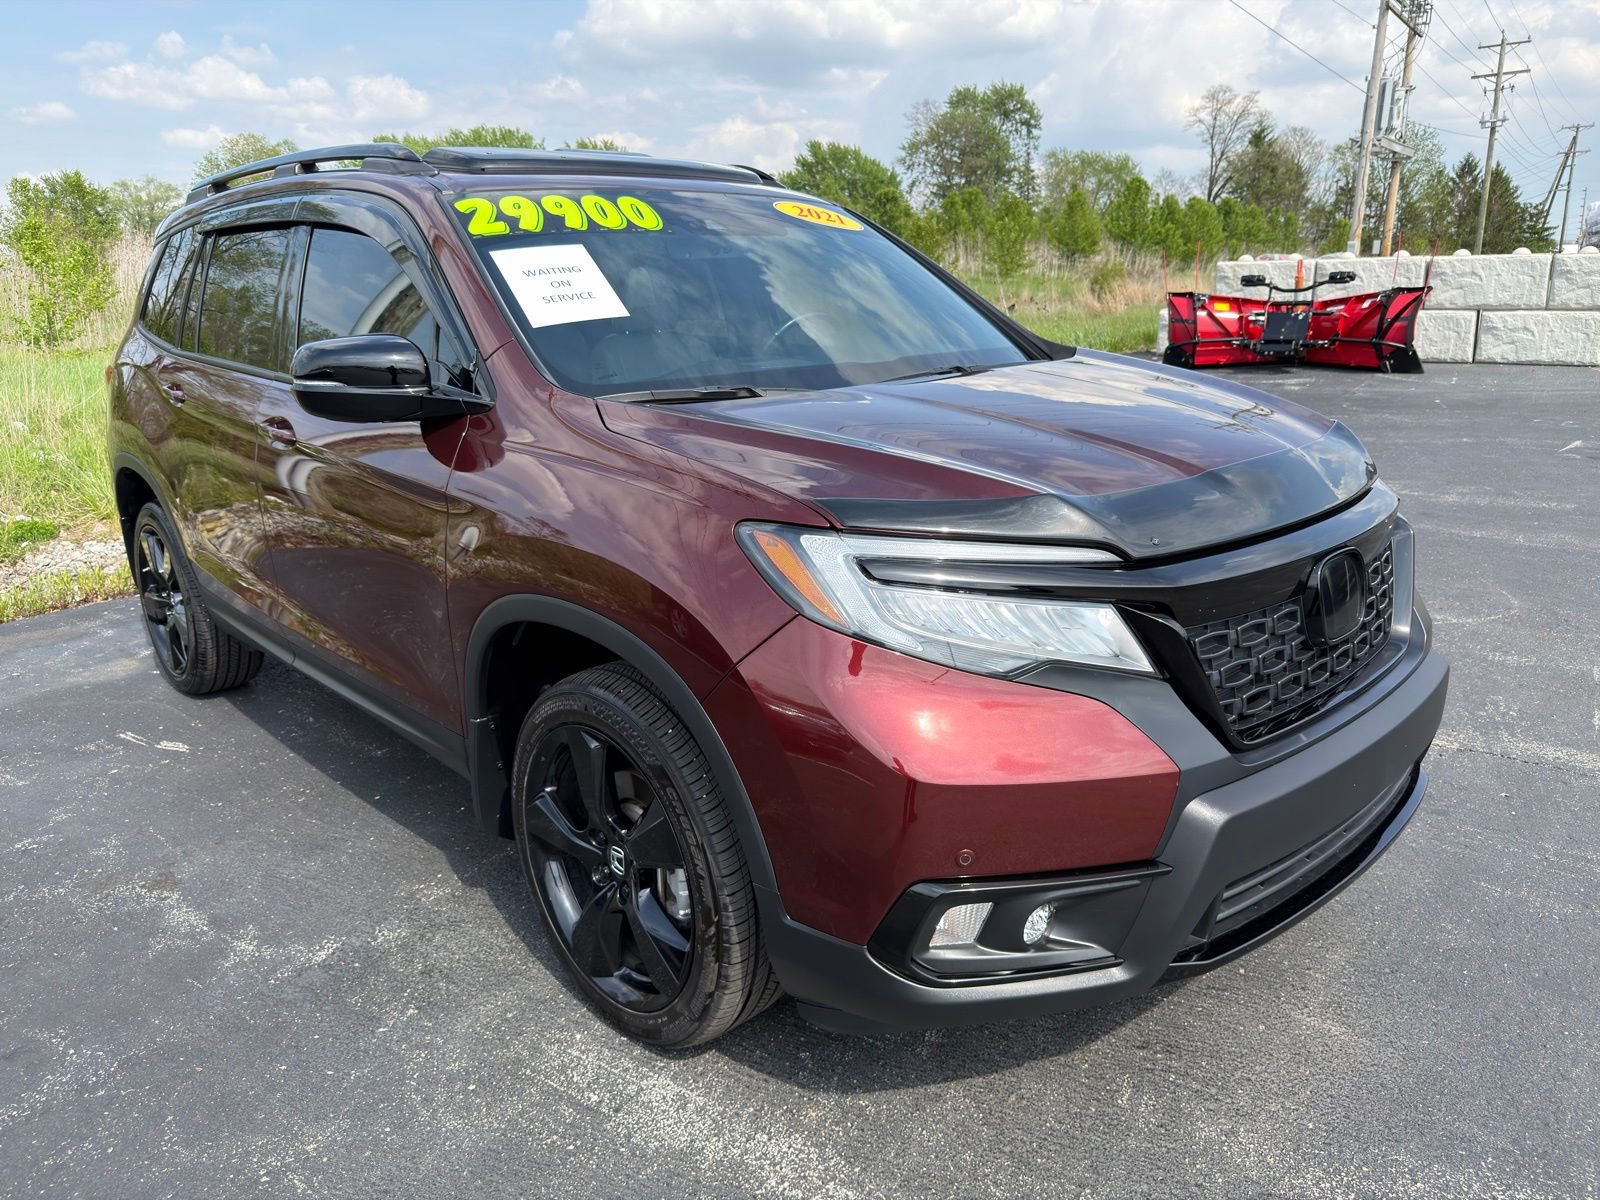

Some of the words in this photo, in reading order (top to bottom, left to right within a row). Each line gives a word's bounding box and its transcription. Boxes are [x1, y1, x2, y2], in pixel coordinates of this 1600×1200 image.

[455, 195, 663, 236] 29900
[792, 205, 846, 226] 2021
[522, 265, 582, 278] WAITING
[550, 280, 572, 289] ON
[542, 291, 597, 304] SERVICE
